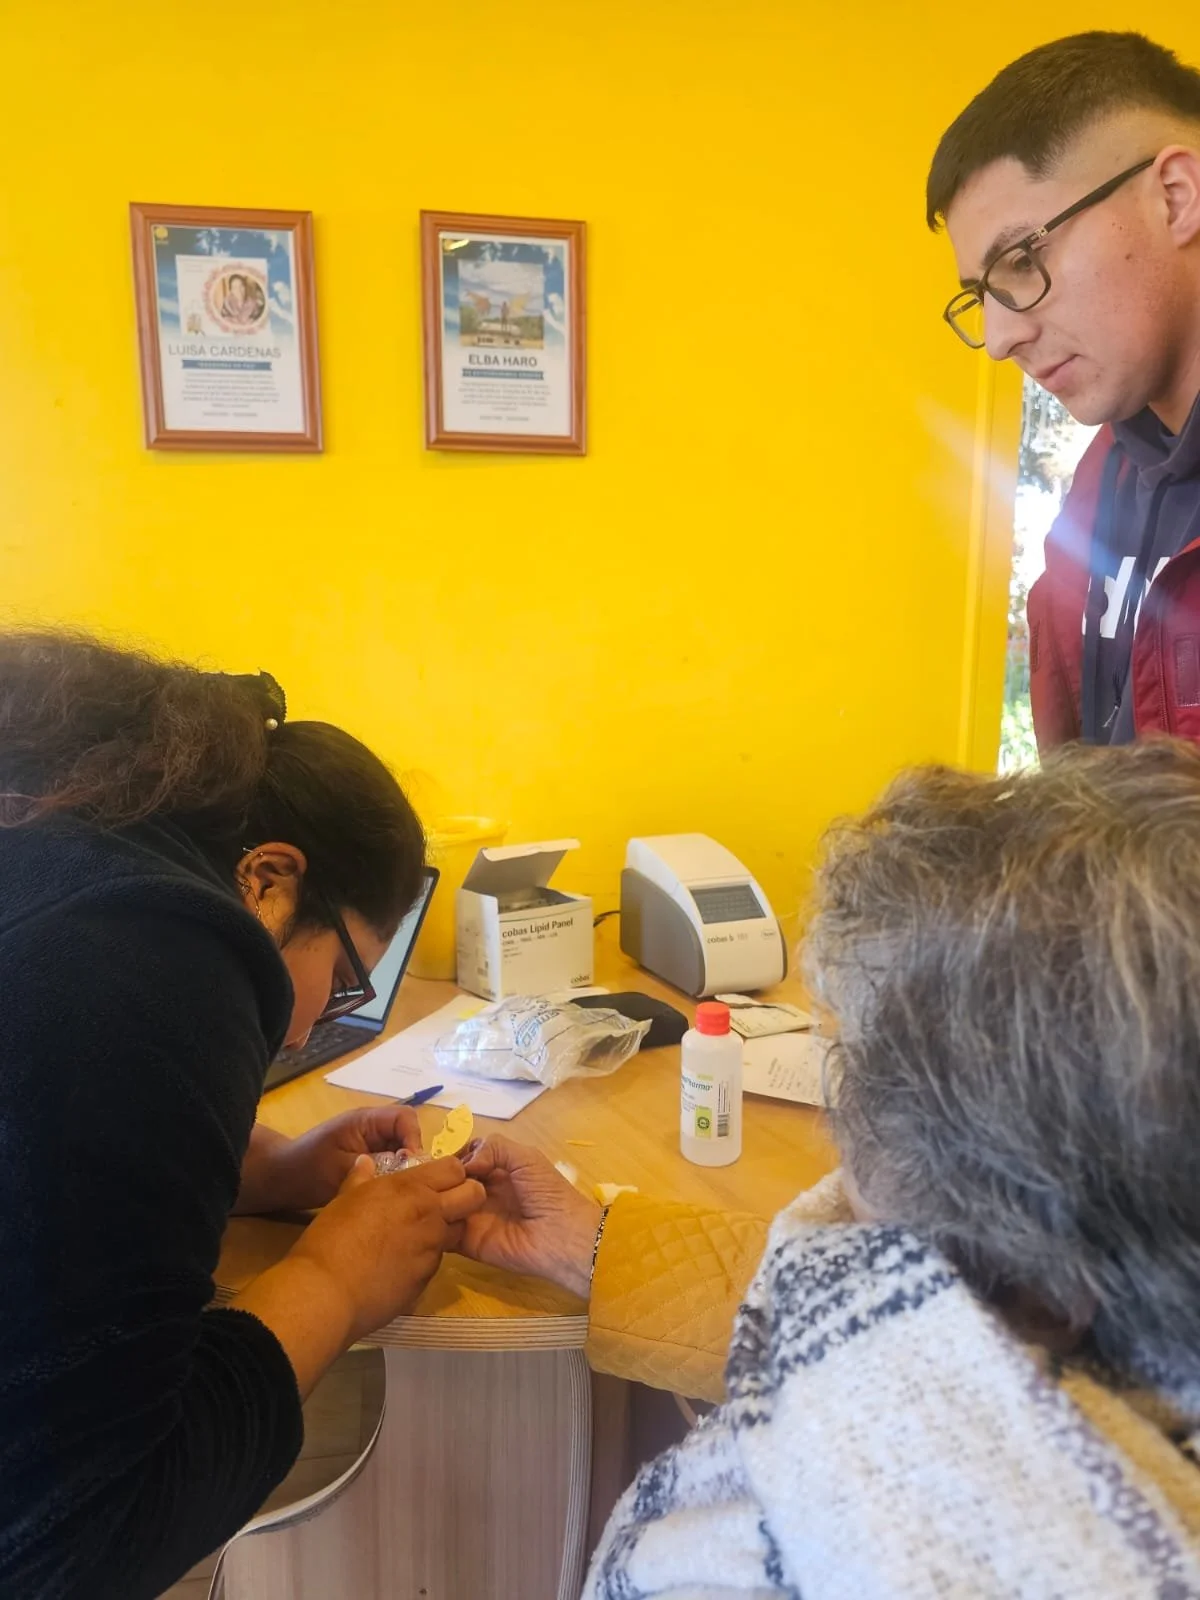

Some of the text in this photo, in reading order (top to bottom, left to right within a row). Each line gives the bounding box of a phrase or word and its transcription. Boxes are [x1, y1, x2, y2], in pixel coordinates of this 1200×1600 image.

[168, 344, 281, 358] LUISA CARDENAS
[468, 354, 538, 368] ELBA HARO
[502, 927, 528, 939] cobas
[530, 922, 550, 935] Lipid
[552, 917, 574, 930] Panel
